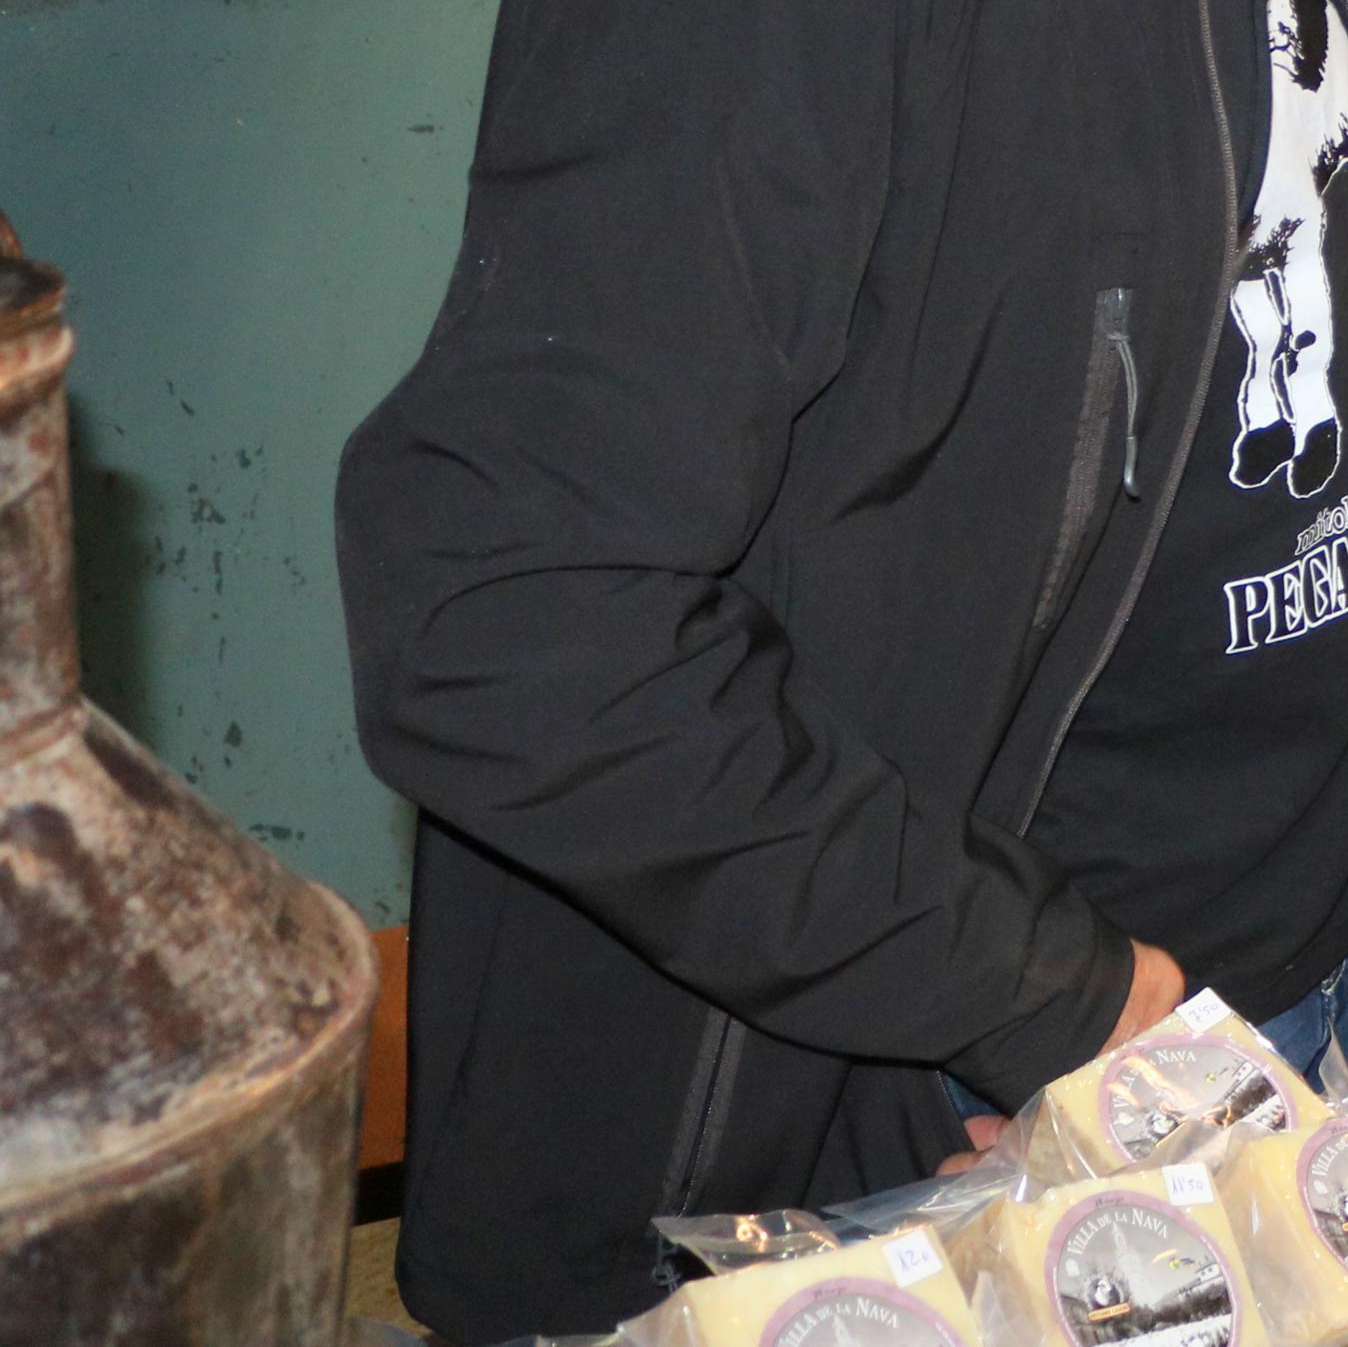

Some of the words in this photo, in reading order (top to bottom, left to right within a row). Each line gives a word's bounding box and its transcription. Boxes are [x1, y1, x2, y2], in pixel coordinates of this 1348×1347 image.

[1156, 1049, 1197, 1064] NAVA
[1312, 1146, 1338, 1177] VILLA
[1067, 1220, 1099, 1256] VILLA
[1097, 1212, 1112, 1227] DE
[1114, 1211, 1128, 1223] LA
[1131, 1207, 1168, 1239] NAVA
[816, 1308, 834, 1321] DE
[836, 1303, 850, 1318] LA
[855, 1296, 898, 1329] NAVA
